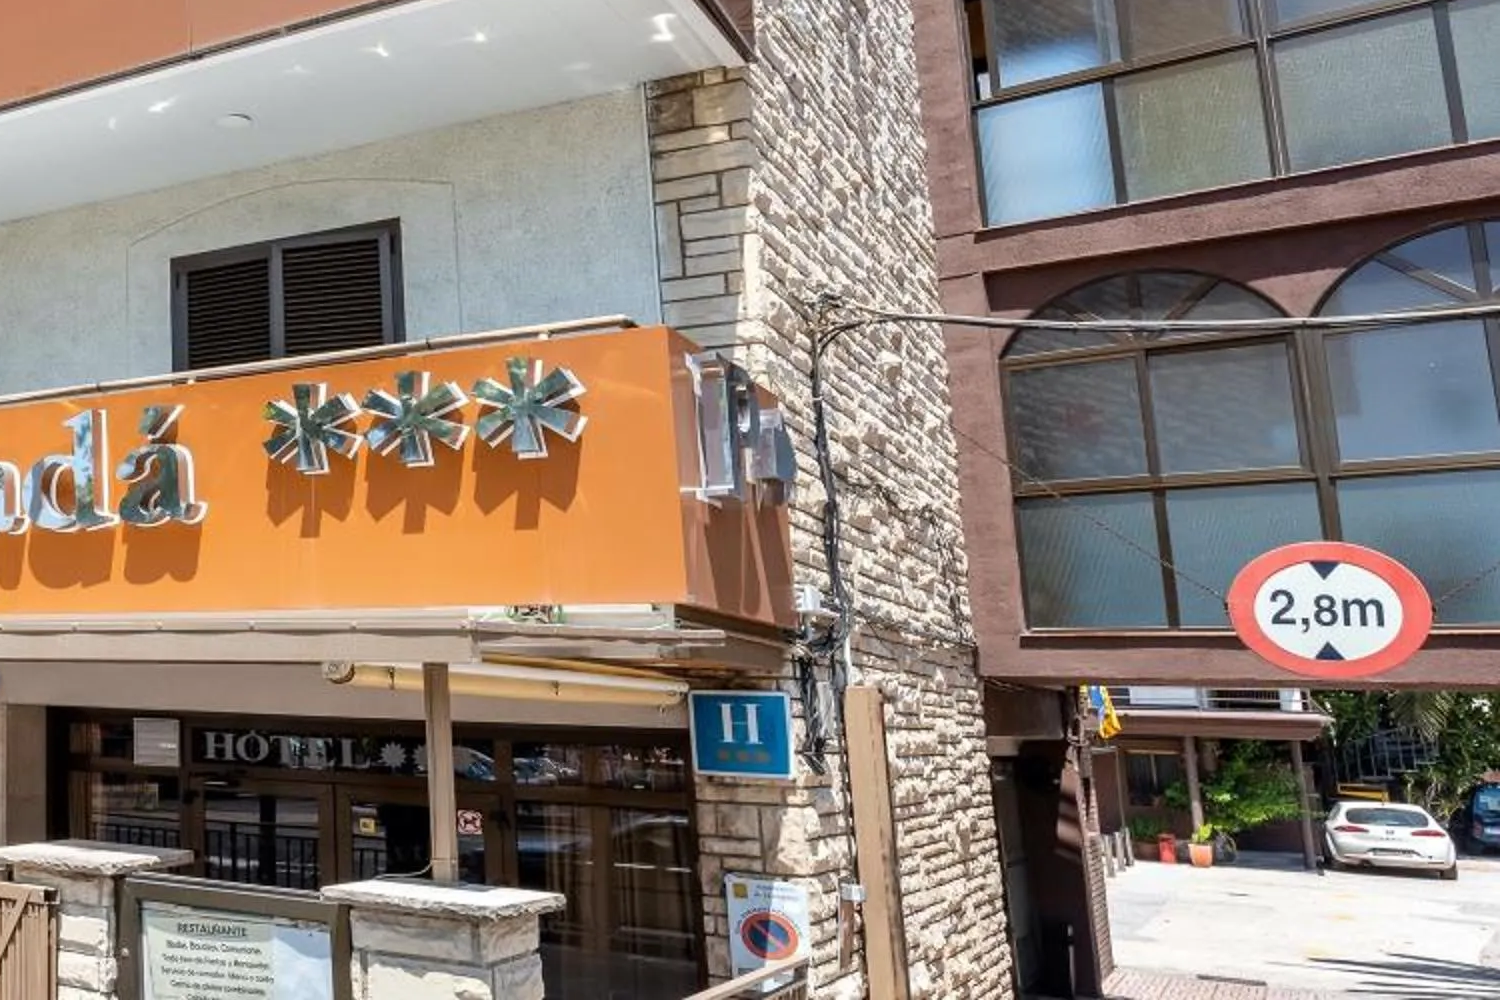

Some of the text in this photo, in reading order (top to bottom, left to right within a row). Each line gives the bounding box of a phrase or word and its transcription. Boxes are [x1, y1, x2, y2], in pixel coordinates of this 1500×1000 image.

[1269, 589, 1385, 634] 2,8m
[719, 703, 763, 745] H
[204, 730, 371, 769] HOTEL
